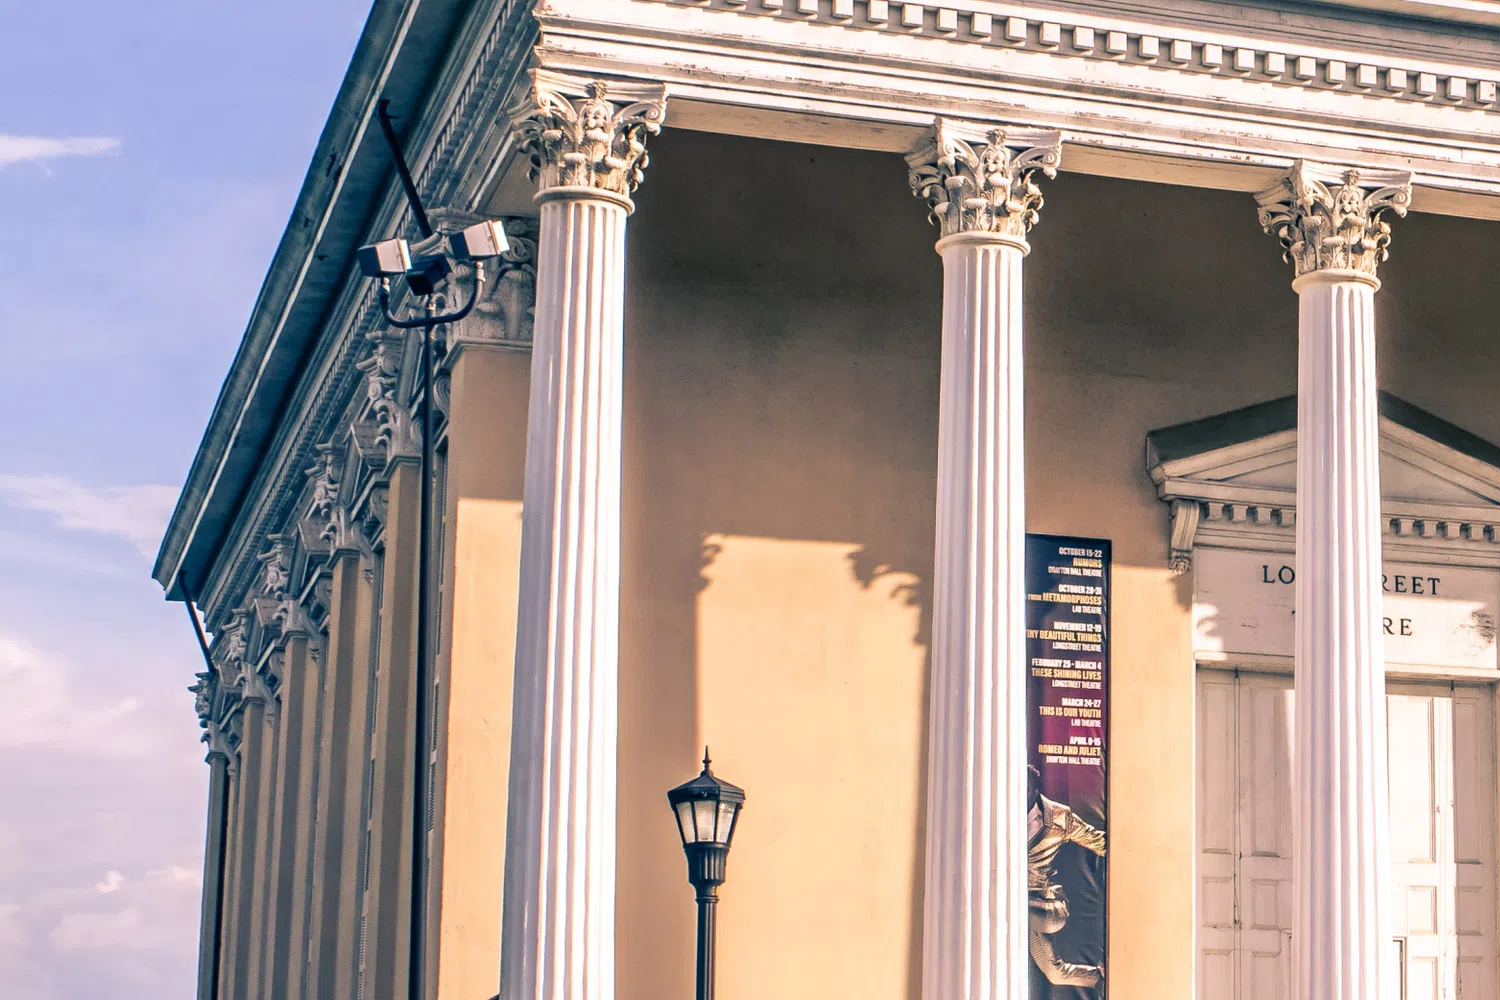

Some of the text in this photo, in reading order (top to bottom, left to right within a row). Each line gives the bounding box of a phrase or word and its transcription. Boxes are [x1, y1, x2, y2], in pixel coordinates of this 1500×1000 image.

[1059, 547, 1102, 558] OCTOBER 15-22
[1072, 558, 1102, 568] RUMORS
[1059, 584, 1085, 594] OCTOBER
[1042, 592, 1102, 605] METAMORPHOSES
[1054, 621, 1086, 630] NOVEMBER
[1040, 630, 1076, 641] BEAUTIFUL
[1077, 632, 1102, 643] THINGS
[1032, 658, 1062, 667] FEBRUARY
[1075, 660, 1096, 669] MARCH
[1032, 668, 1101, 680] THESE SHINING LIVES
[1062, 698, 1101, 707] MARCH 24-27
[1039, 706, 1101, 718] THIS IS OUR YOUTH
[1070, 736, 1087, 745] APRIL
[1038, 744, 1101, 756] ROMEO AND JULIET
